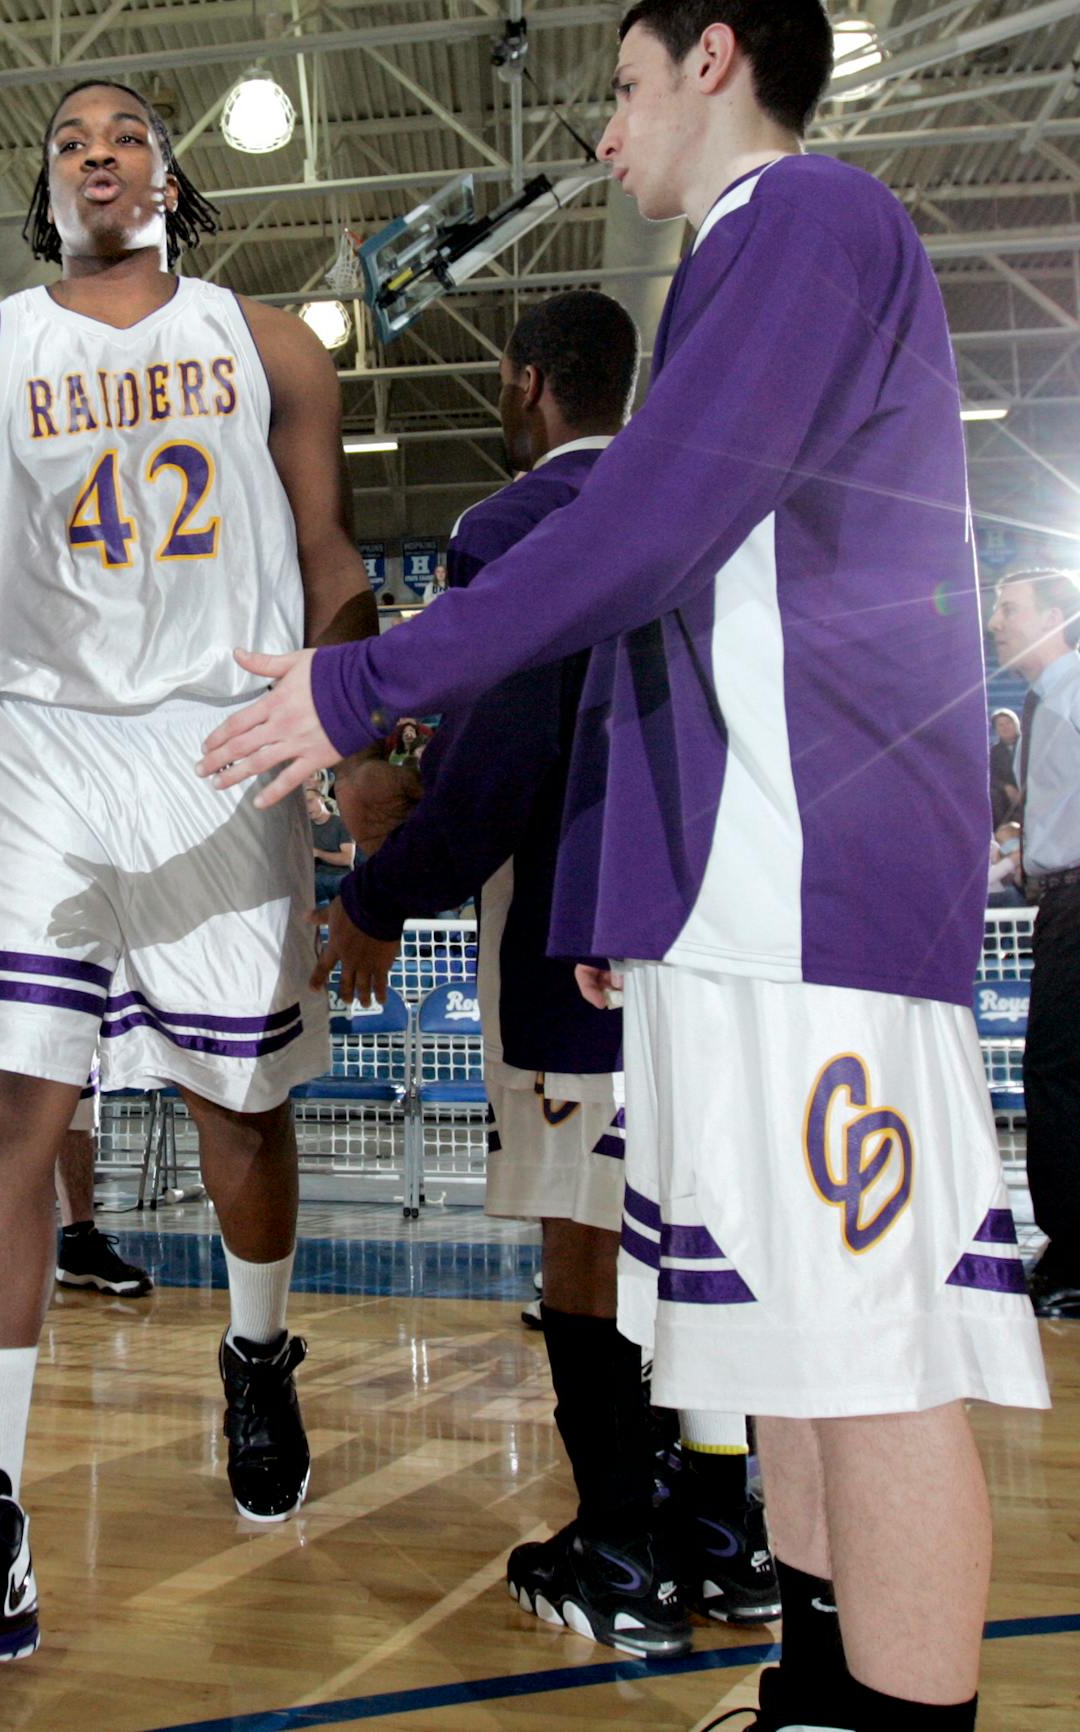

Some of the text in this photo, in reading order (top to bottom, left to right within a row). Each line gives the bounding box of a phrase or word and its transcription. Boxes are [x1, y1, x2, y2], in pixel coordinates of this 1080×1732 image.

[26, 355, 238, 439] RAIDERS
[67, 437, 221, 569] 42
[411, 555, 431, 575] H
